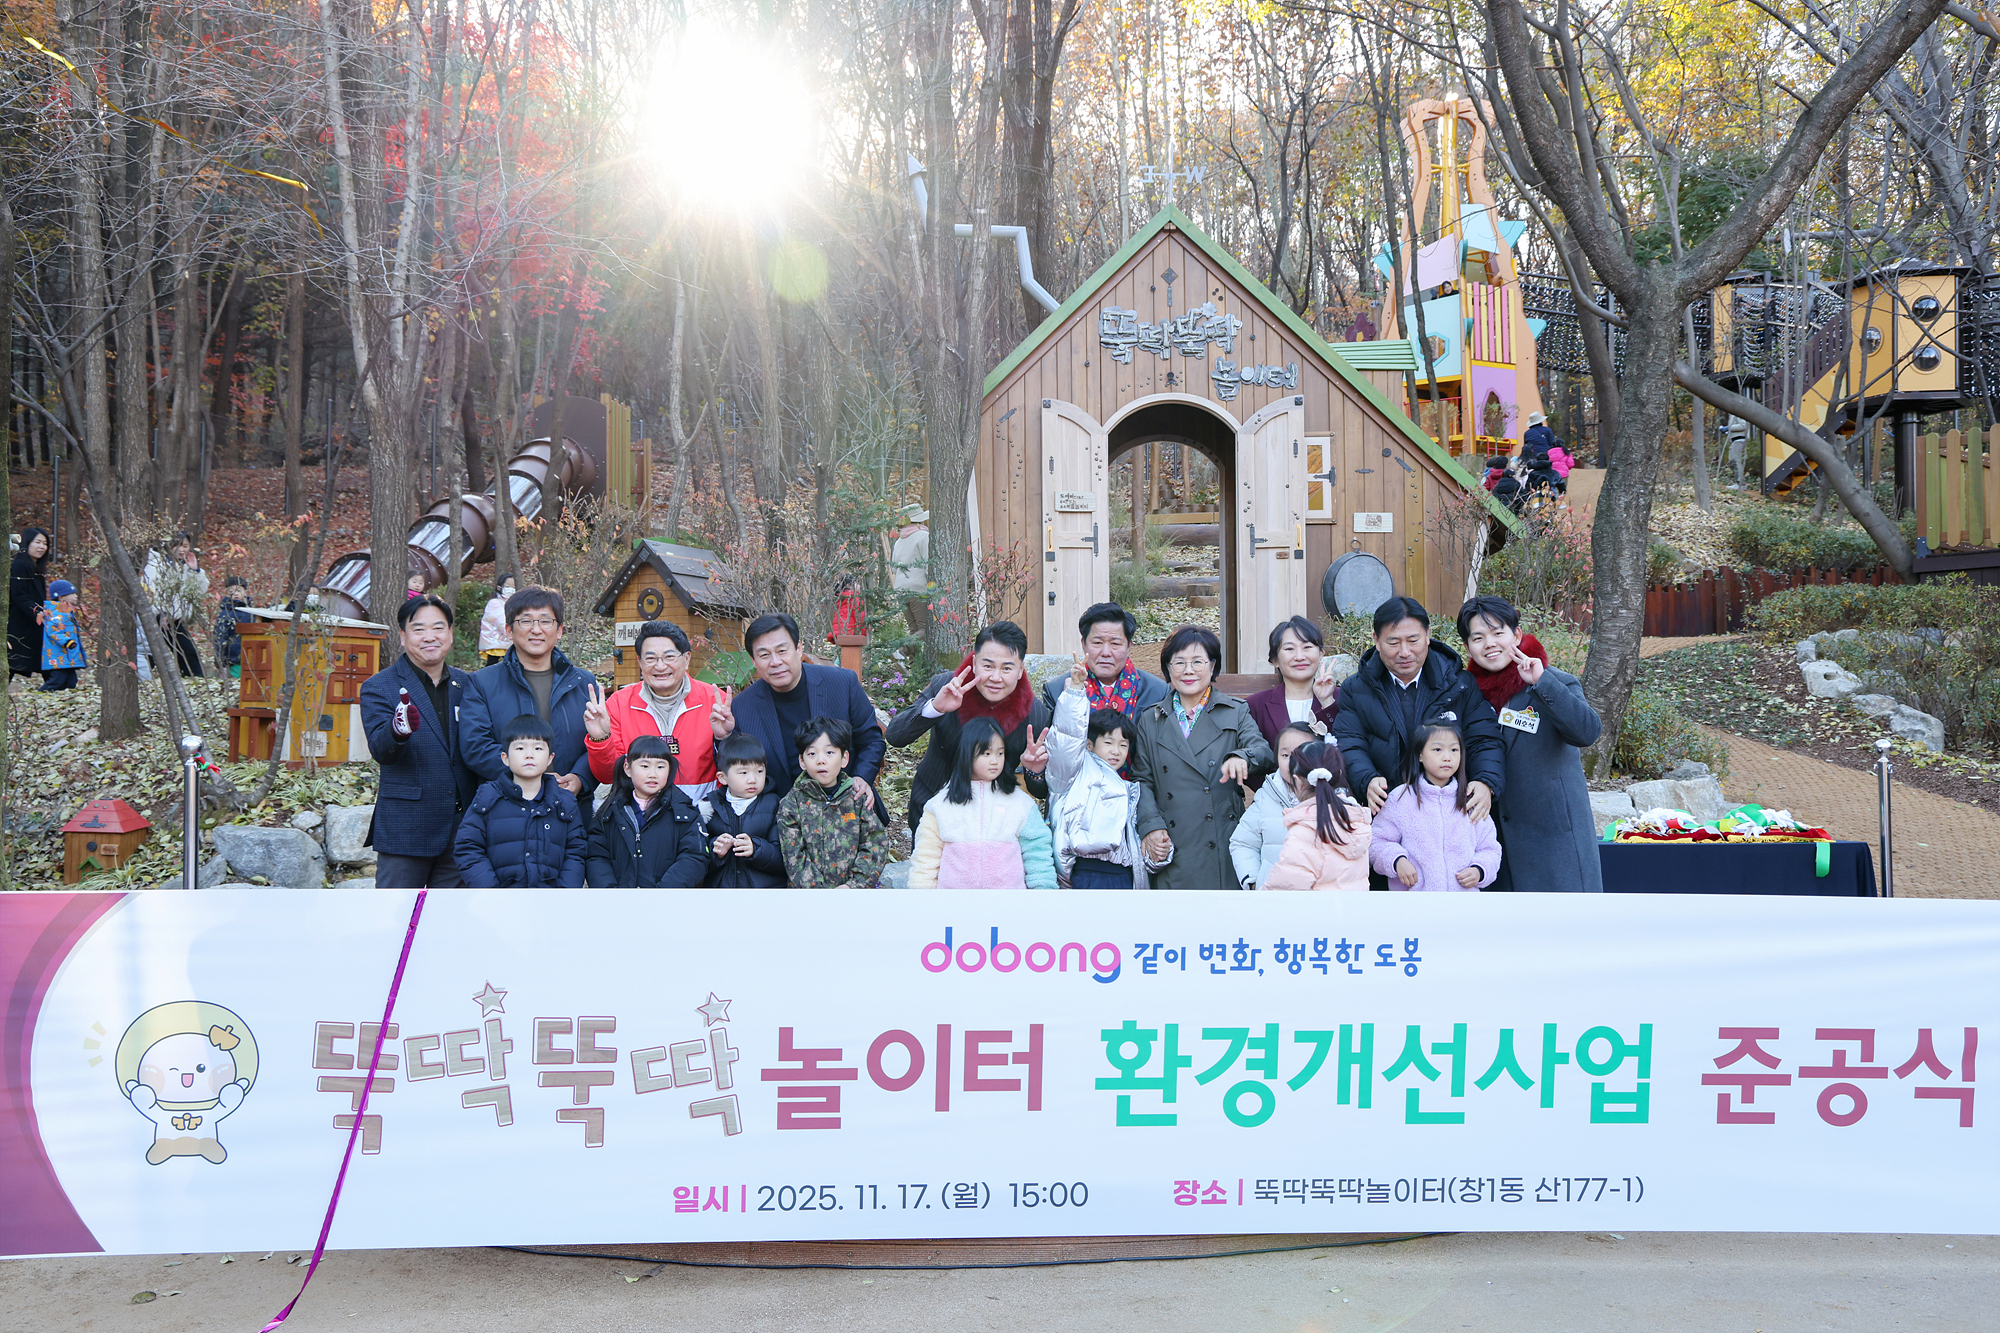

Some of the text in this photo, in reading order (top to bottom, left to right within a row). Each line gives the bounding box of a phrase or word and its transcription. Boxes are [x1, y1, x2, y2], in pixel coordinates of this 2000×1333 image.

[1211, 356, 1298, 401] 놀이터
[921, 927, 1422, 984] dobong 같이 변화, 행복한 도봉
[1095, 1020, 1653, 1128] 환경개선사업
[1701, 1027, 1978, 1128] 준공식
[673, 1182, 1089, 1213] 일시 2025. 11. 17. (월) 15:00
[1173, 1176, 1644, 1206] 장소 뚝딱뚝딱놀이터(창1동 산177-1)
